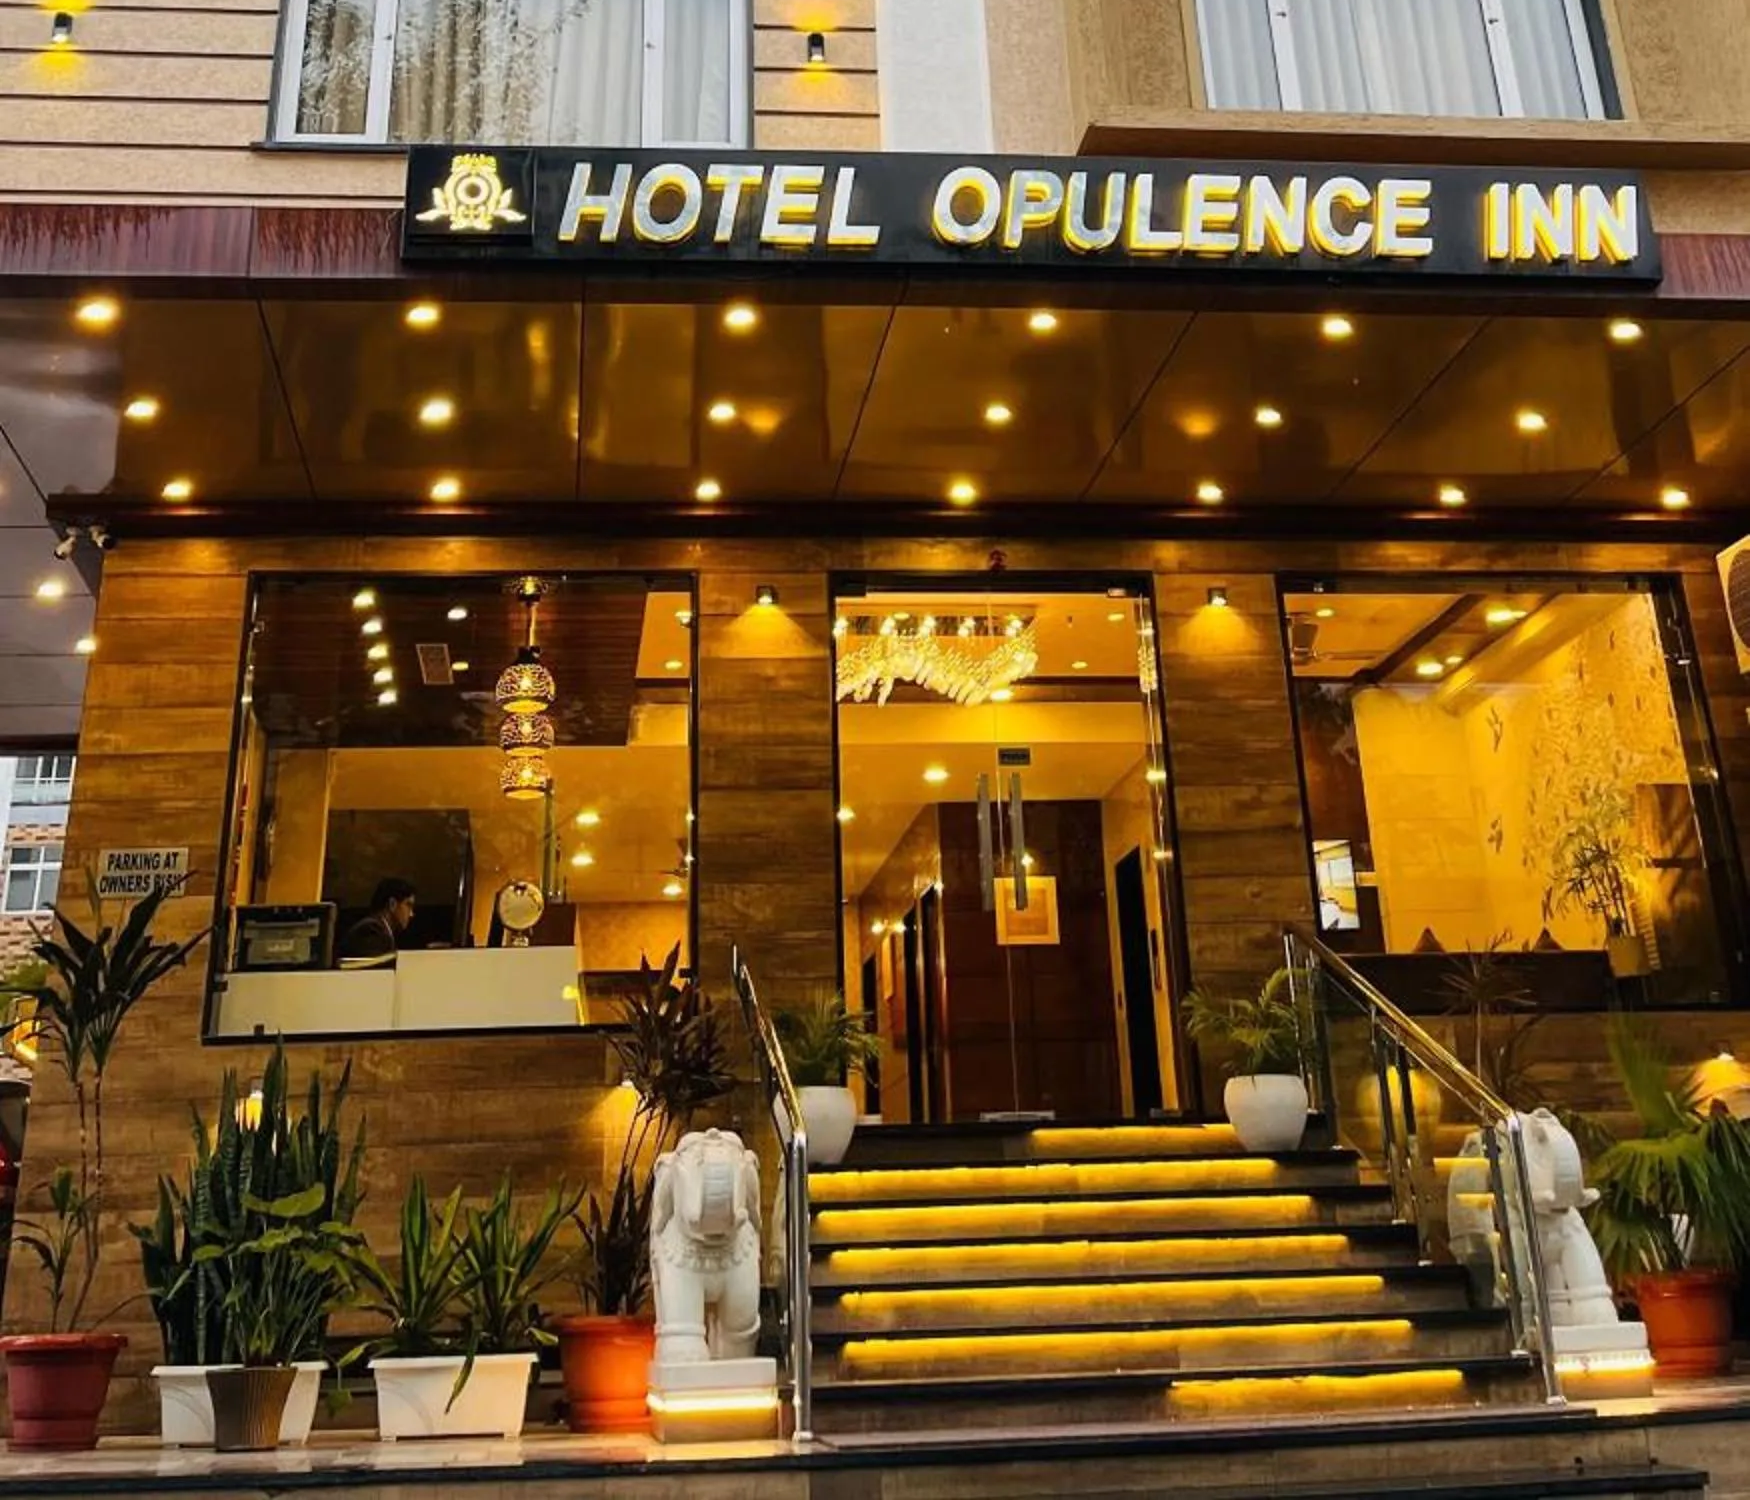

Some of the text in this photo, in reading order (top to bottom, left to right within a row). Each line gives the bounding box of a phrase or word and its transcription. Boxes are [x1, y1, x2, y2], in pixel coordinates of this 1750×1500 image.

[558, 163, 1639, 262] HOTEL OPULENCE INN
[107, 852, 179, 871] PARKING AT
[100, 874, 151, 893] OWNERS
